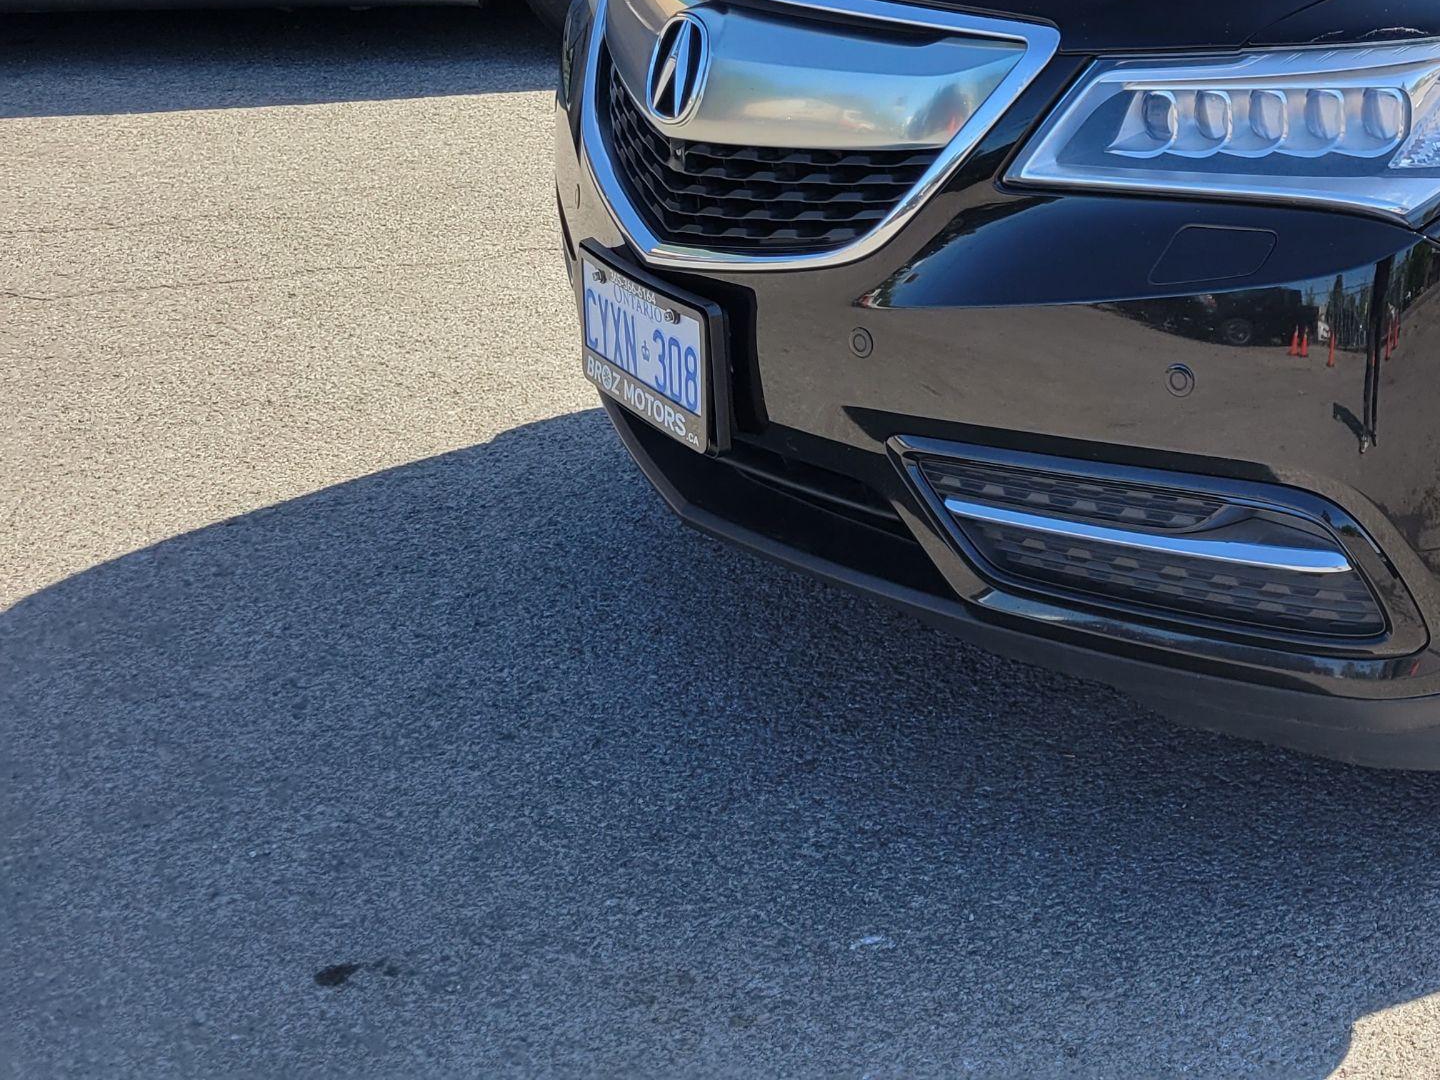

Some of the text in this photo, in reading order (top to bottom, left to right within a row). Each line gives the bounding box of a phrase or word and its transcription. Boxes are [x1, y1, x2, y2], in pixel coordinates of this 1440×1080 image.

[613, 283, 662, 323] ONTARIO
[586, 288, 698, 412] CYXN 308
